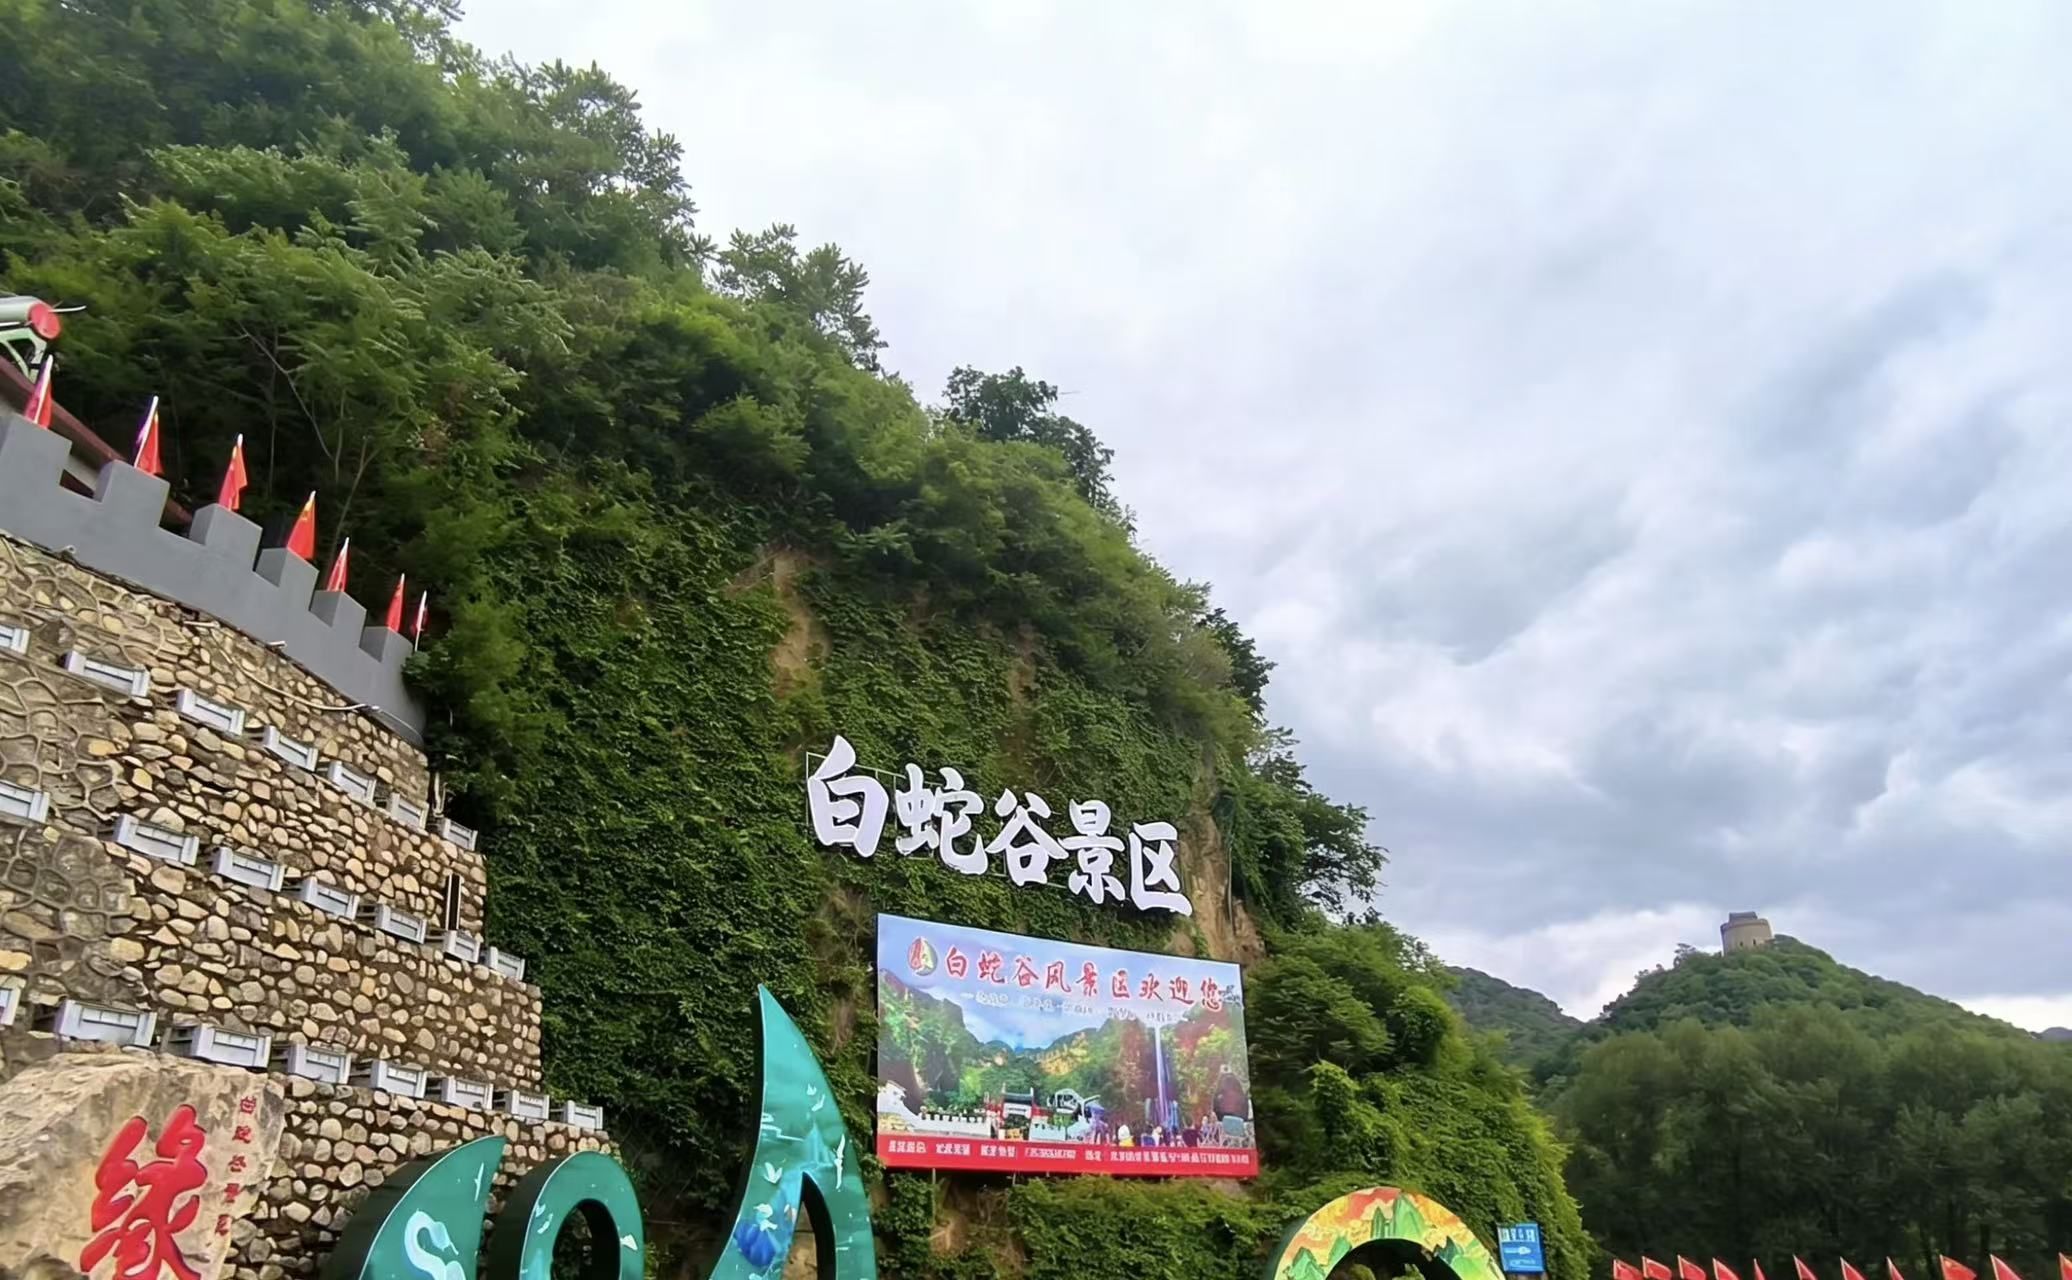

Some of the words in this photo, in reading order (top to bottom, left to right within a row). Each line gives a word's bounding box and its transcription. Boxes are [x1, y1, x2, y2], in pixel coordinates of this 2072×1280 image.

[807, 735, 1193, 917] 白蛇谷景区
[944, 945, 1222, 1012] 白蛇谷风景区欢迎您
